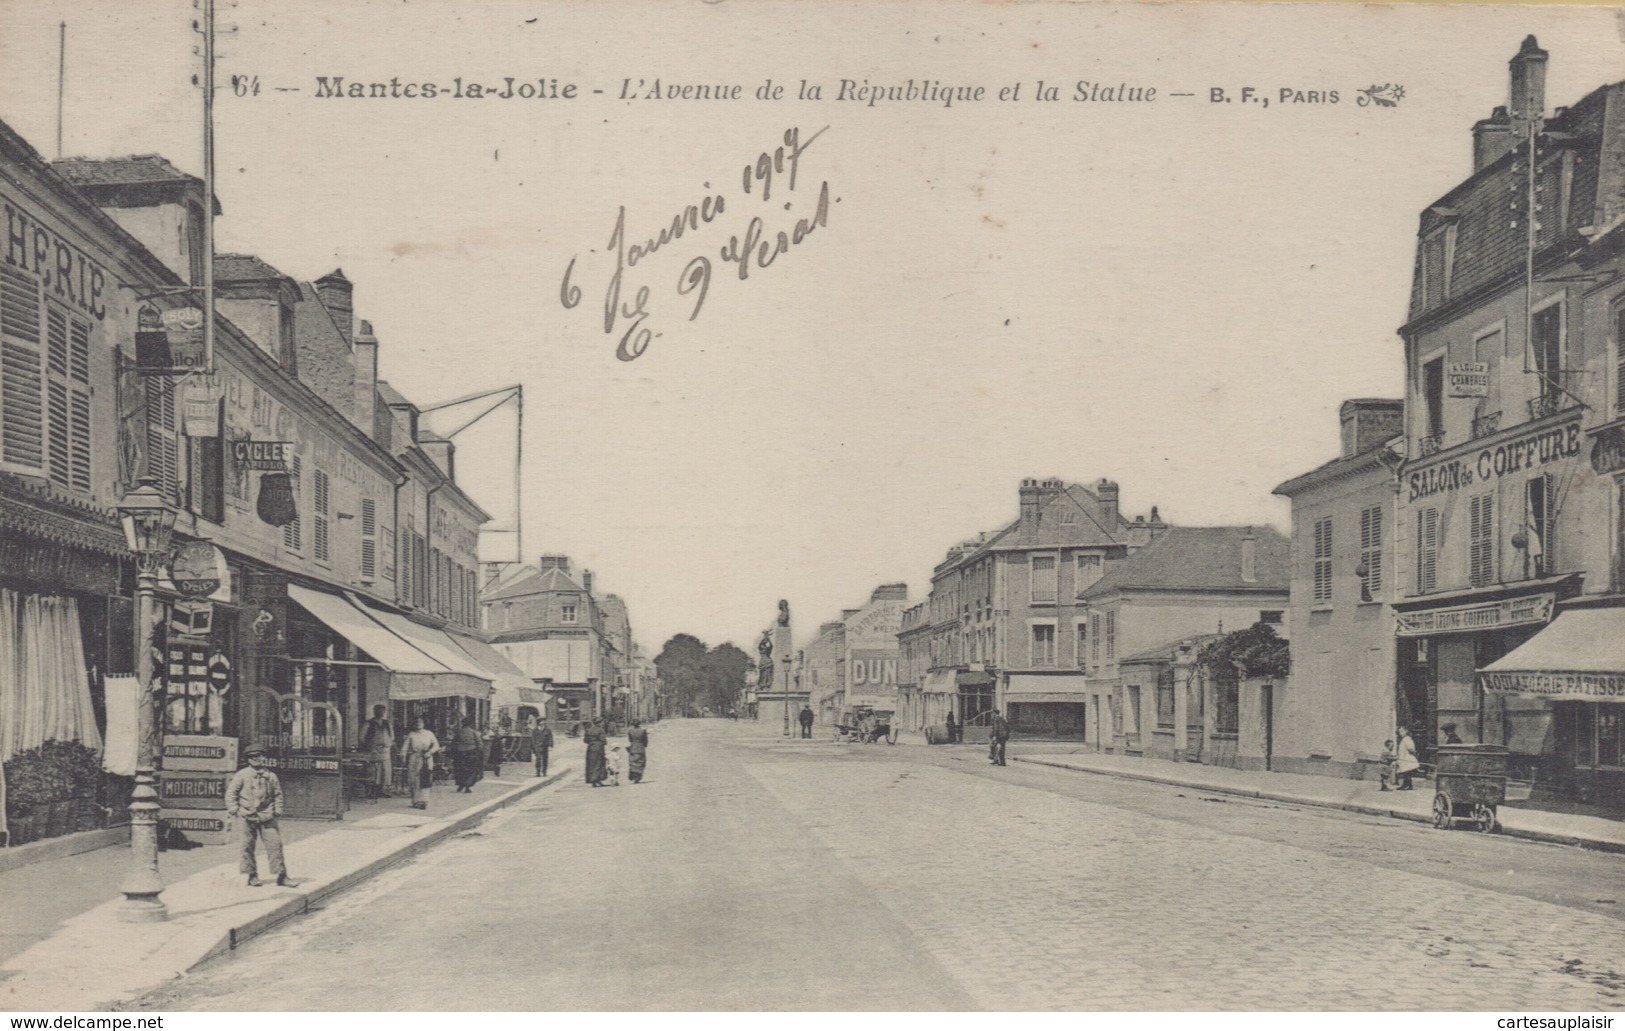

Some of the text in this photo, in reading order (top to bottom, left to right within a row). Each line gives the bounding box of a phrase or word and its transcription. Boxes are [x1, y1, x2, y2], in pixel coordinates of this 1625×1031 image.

[234, 441, 291, 461] CYCLES
[1408, 460, 1460, 503] SALON
[1460, 464, 1474, 487] de
[1477, 423, 1582, 482] COIFFURE
[1463, 608, 1501, 627] COIFFEUR
[164, 746, 222, 758] AUTOMOBILINE
[165, 781, 223, 795] MOTRICINE
